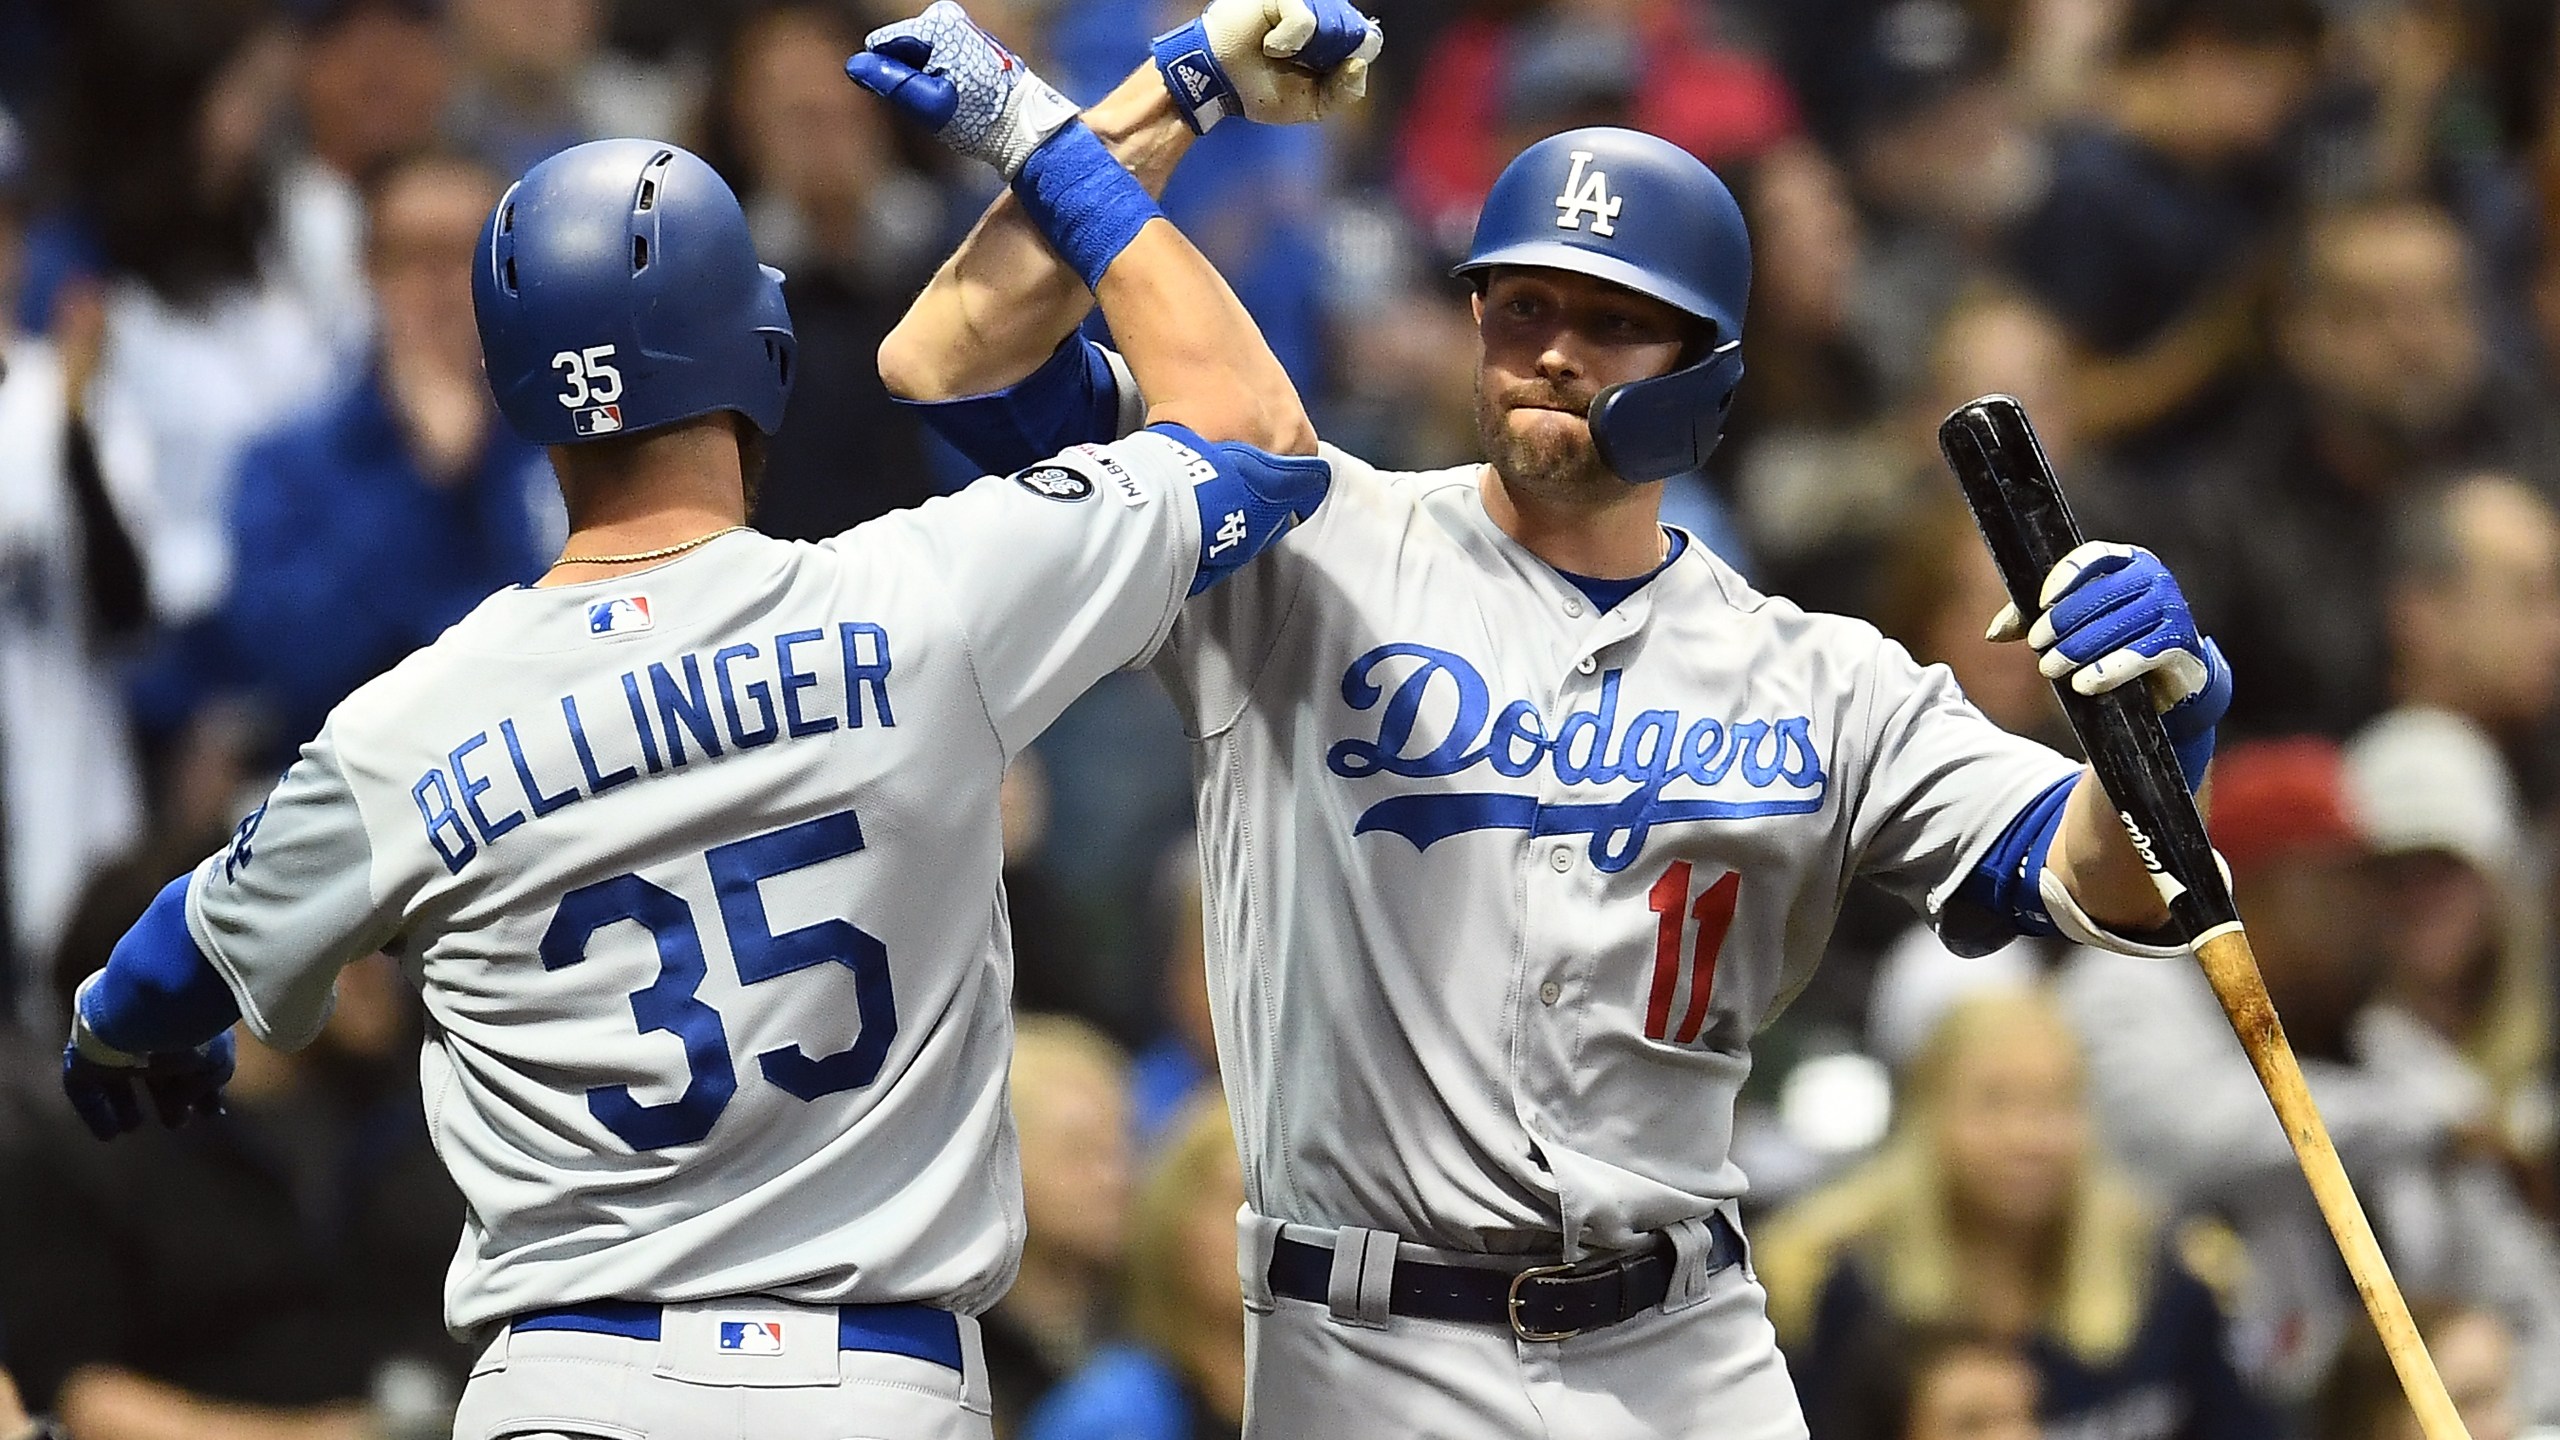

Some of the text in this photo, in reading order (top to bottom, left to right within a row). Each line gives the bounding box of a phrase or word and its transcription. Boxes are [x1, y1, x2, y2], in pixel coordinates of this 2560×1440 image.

[1177, 64, 1203, 102] adidas
[1556, 150, 1622, 236] LA
[552, 344, 623, 408] 35
[411, 621, 896, 876] BELLINGER
[1326, 642, 1828, 873] Dodgers
[538, 809, 899, 1152] 35
[1644, 860, 1741, 1044] 11
